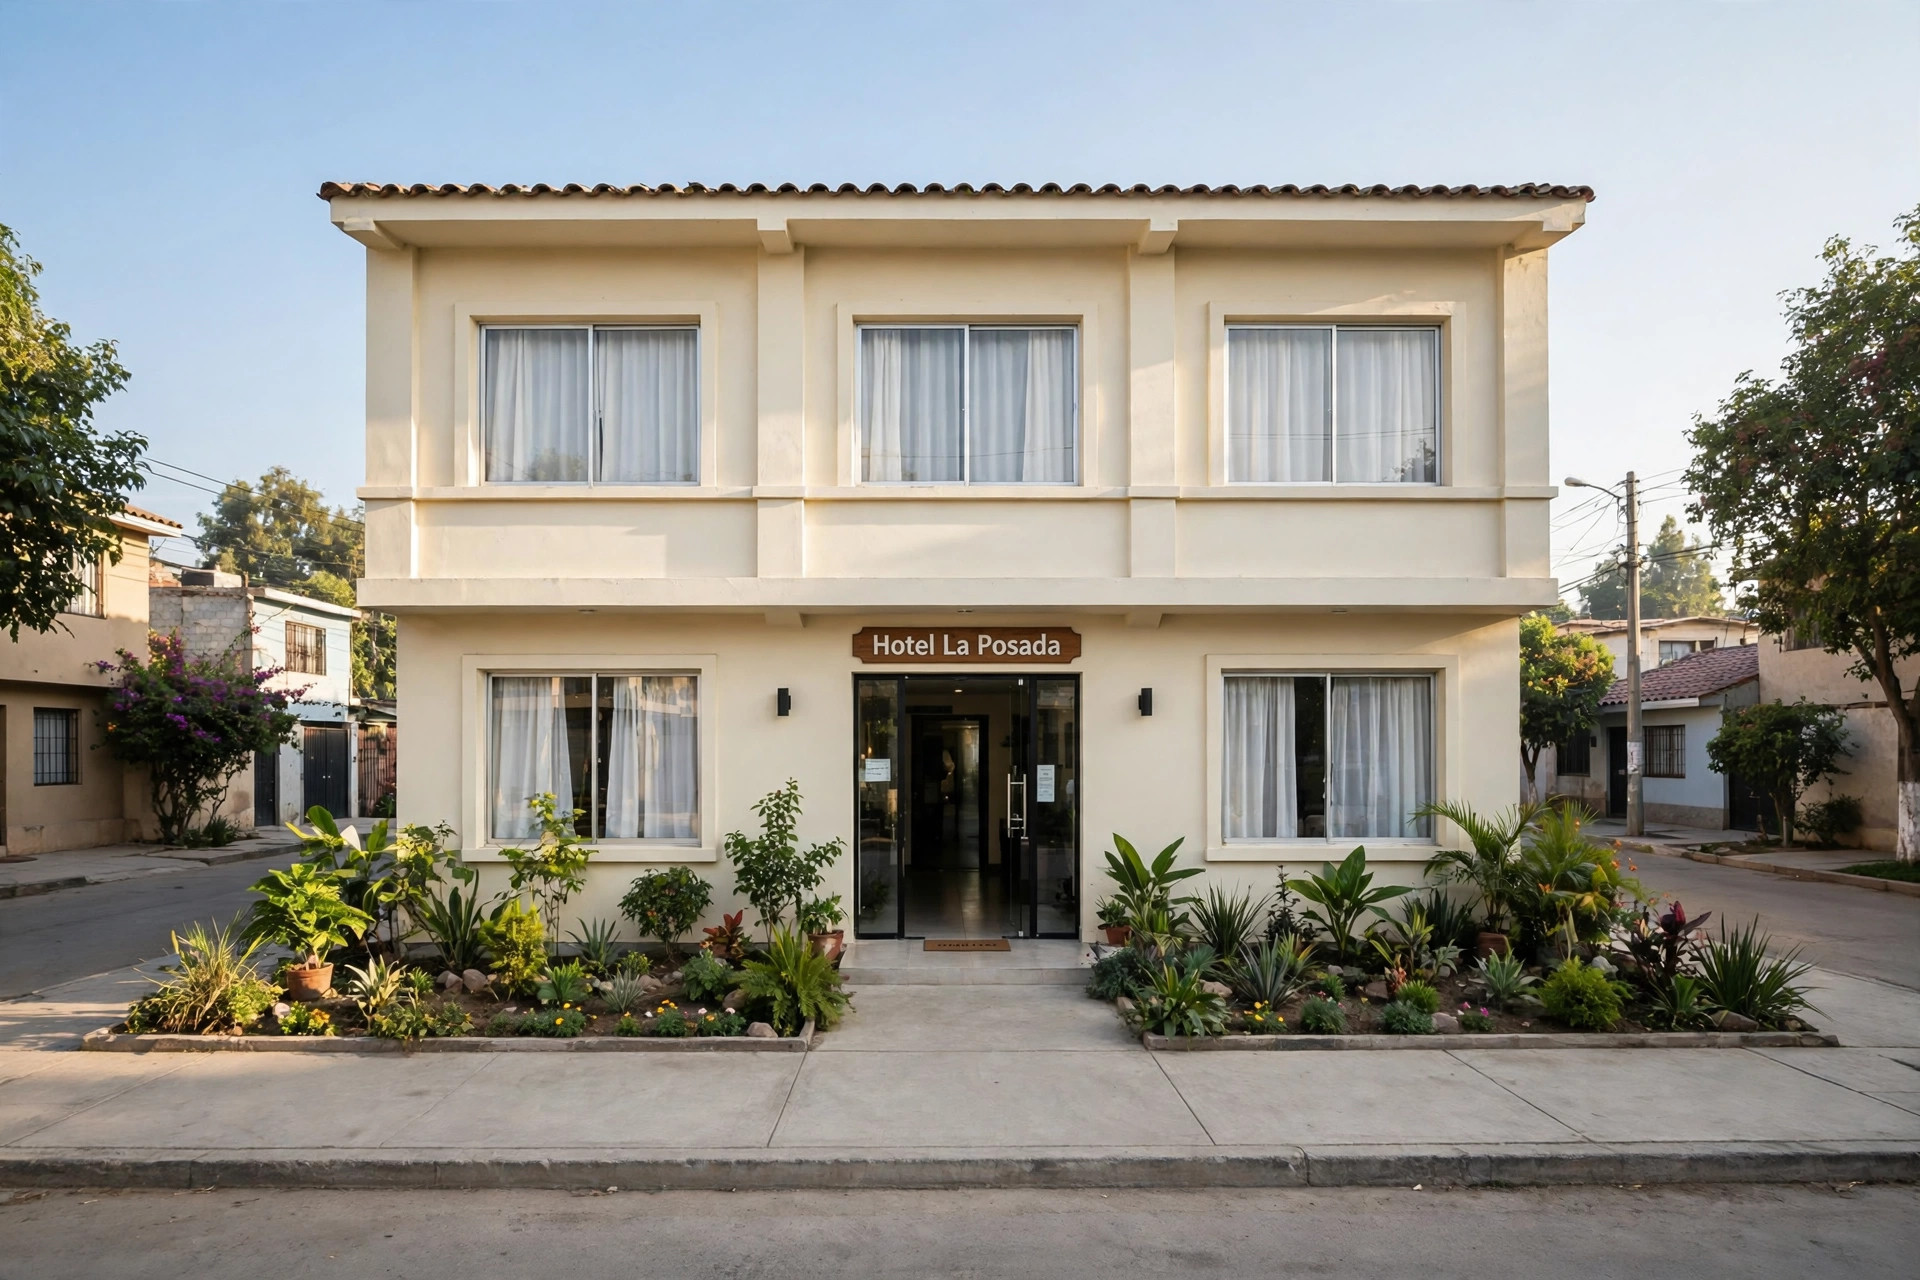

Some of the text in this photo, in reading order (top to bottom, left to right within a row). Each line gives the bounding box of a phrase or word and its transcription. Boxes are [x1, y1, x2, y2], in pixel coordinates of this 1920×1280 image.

[873, 633, 1061, 656] Hotel La Posada
